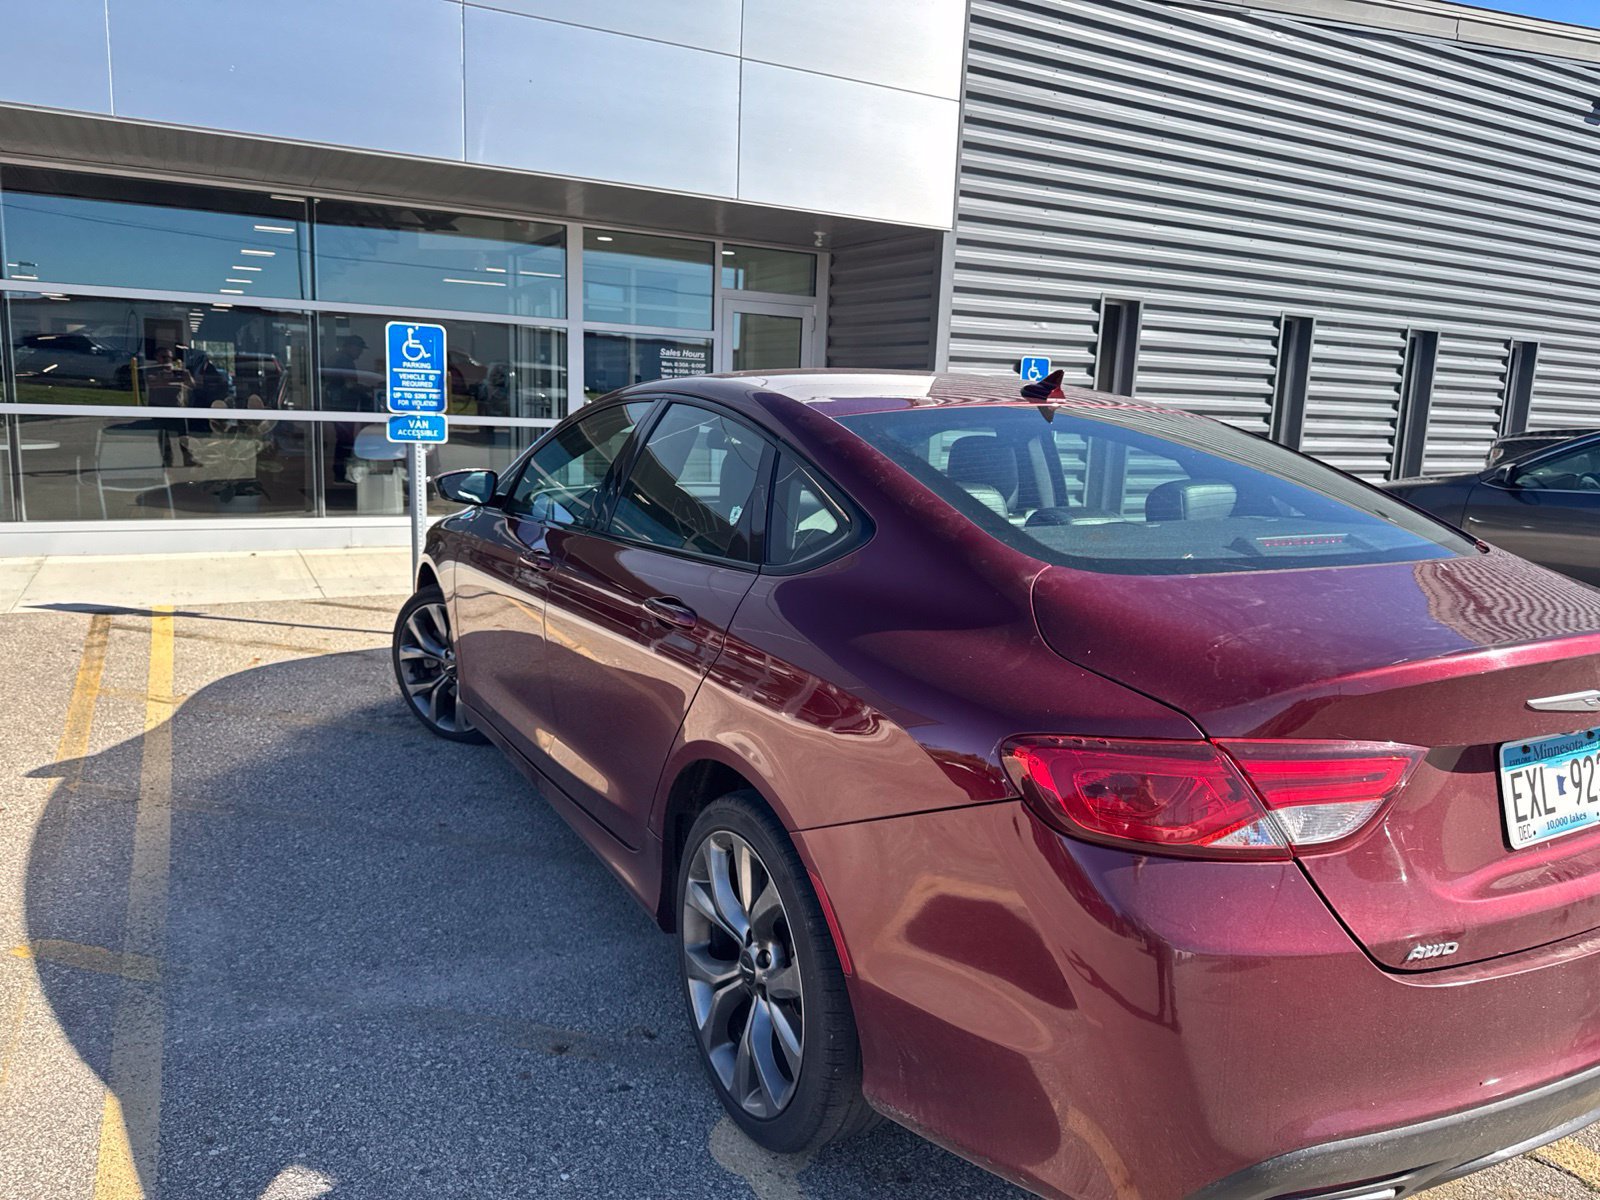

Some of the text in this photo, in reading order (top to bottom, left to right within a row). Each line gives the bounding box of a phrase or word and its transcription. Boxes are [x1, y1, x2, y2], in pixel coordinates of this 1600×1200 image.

[660, 348, 705, 359] Sales Hours
[402, 361, 432, 369] PARKING
[398, 373, 426, 381] VEHICLE
[401, 380, 433, 388] REQUIRED
[407, 419, 429, 429] VAN
[397, 429, 439, 437] ACCESSIBLE
[1510, 766, 1557, 824] EXL
[1518, 812, 1588, 841] DEC 10,000 lakes
[1406, 941, 1460, 961] AWD
